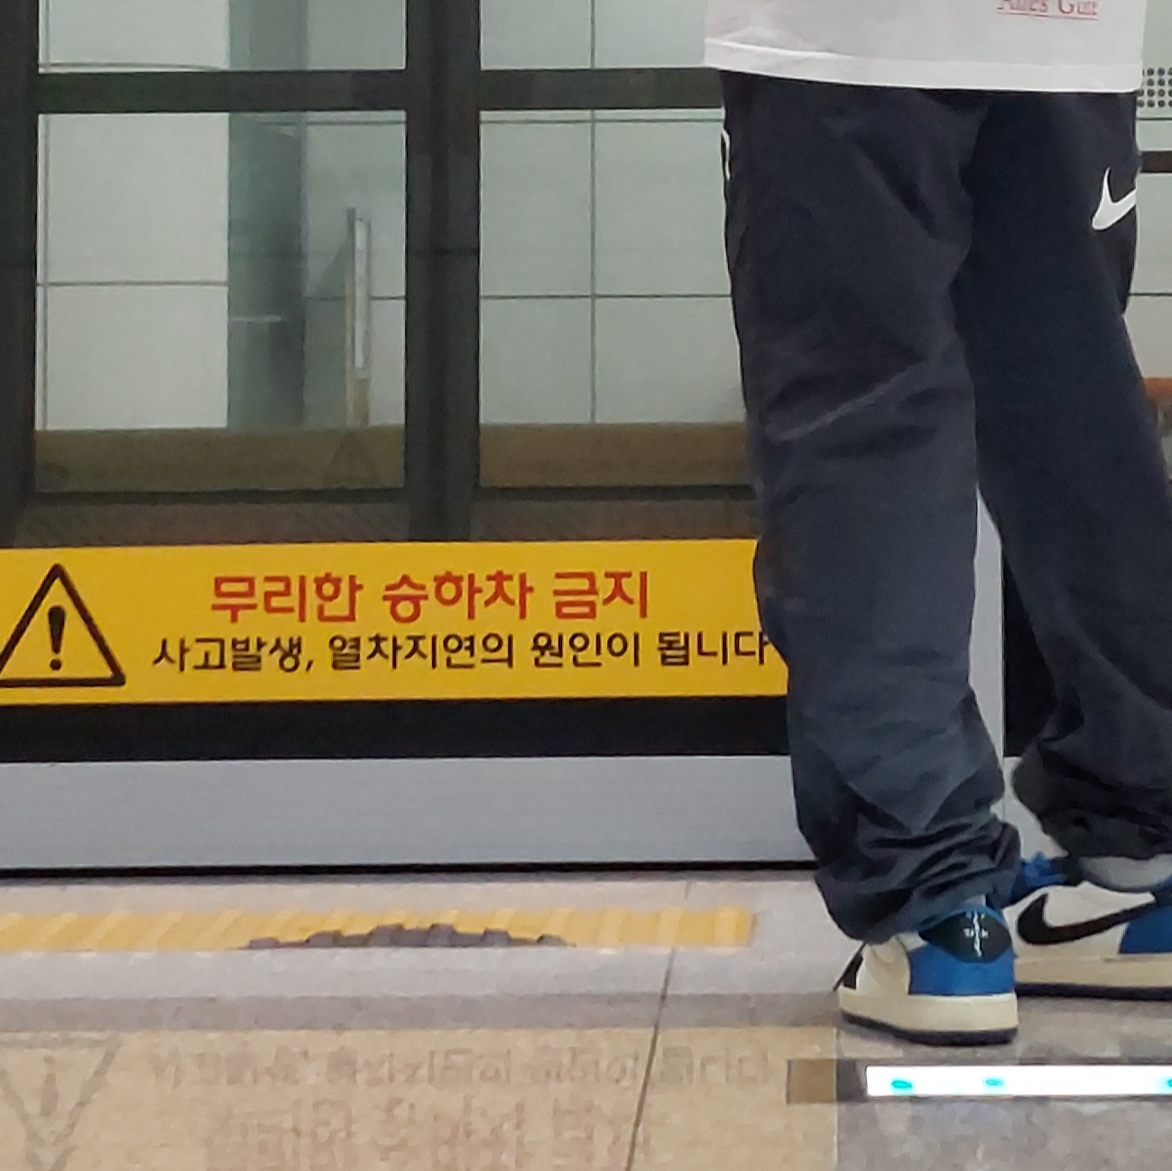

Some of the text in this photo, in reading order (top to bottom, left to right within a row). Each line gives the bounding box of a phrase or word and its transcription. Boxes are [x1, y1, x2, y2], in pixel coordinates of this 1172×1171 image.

[211, 570, 648, 624] 무리한 승하차 금지
[152, 631, 769, 672] 사고발생, 열차지연의 원인이 됩니다
